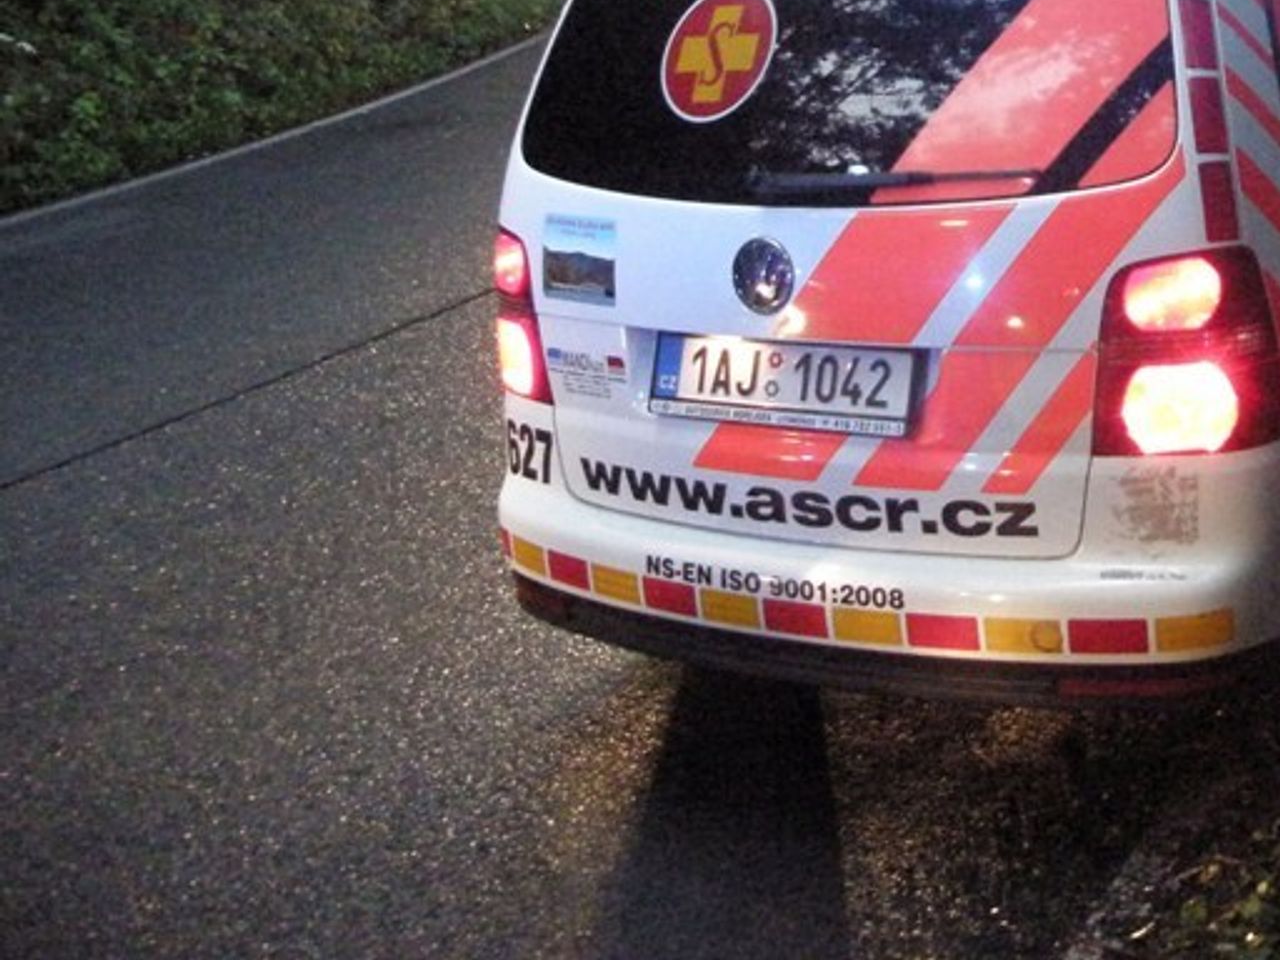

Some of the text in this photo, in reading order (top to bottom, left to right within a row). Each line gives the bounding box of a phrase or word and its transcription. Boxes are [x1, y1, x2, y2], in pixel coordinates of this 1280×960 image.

[659, 374, 678, 390] CZ
[692, 345, 762, 397] 1AJ
[794, 352, 892, 409] 1042
[507, 419, 554, 484] 627
[580, 457, 1039, 537] www.ascr.cz
[646, 554, 905, 609] NS-EN ISO 9001:2008
